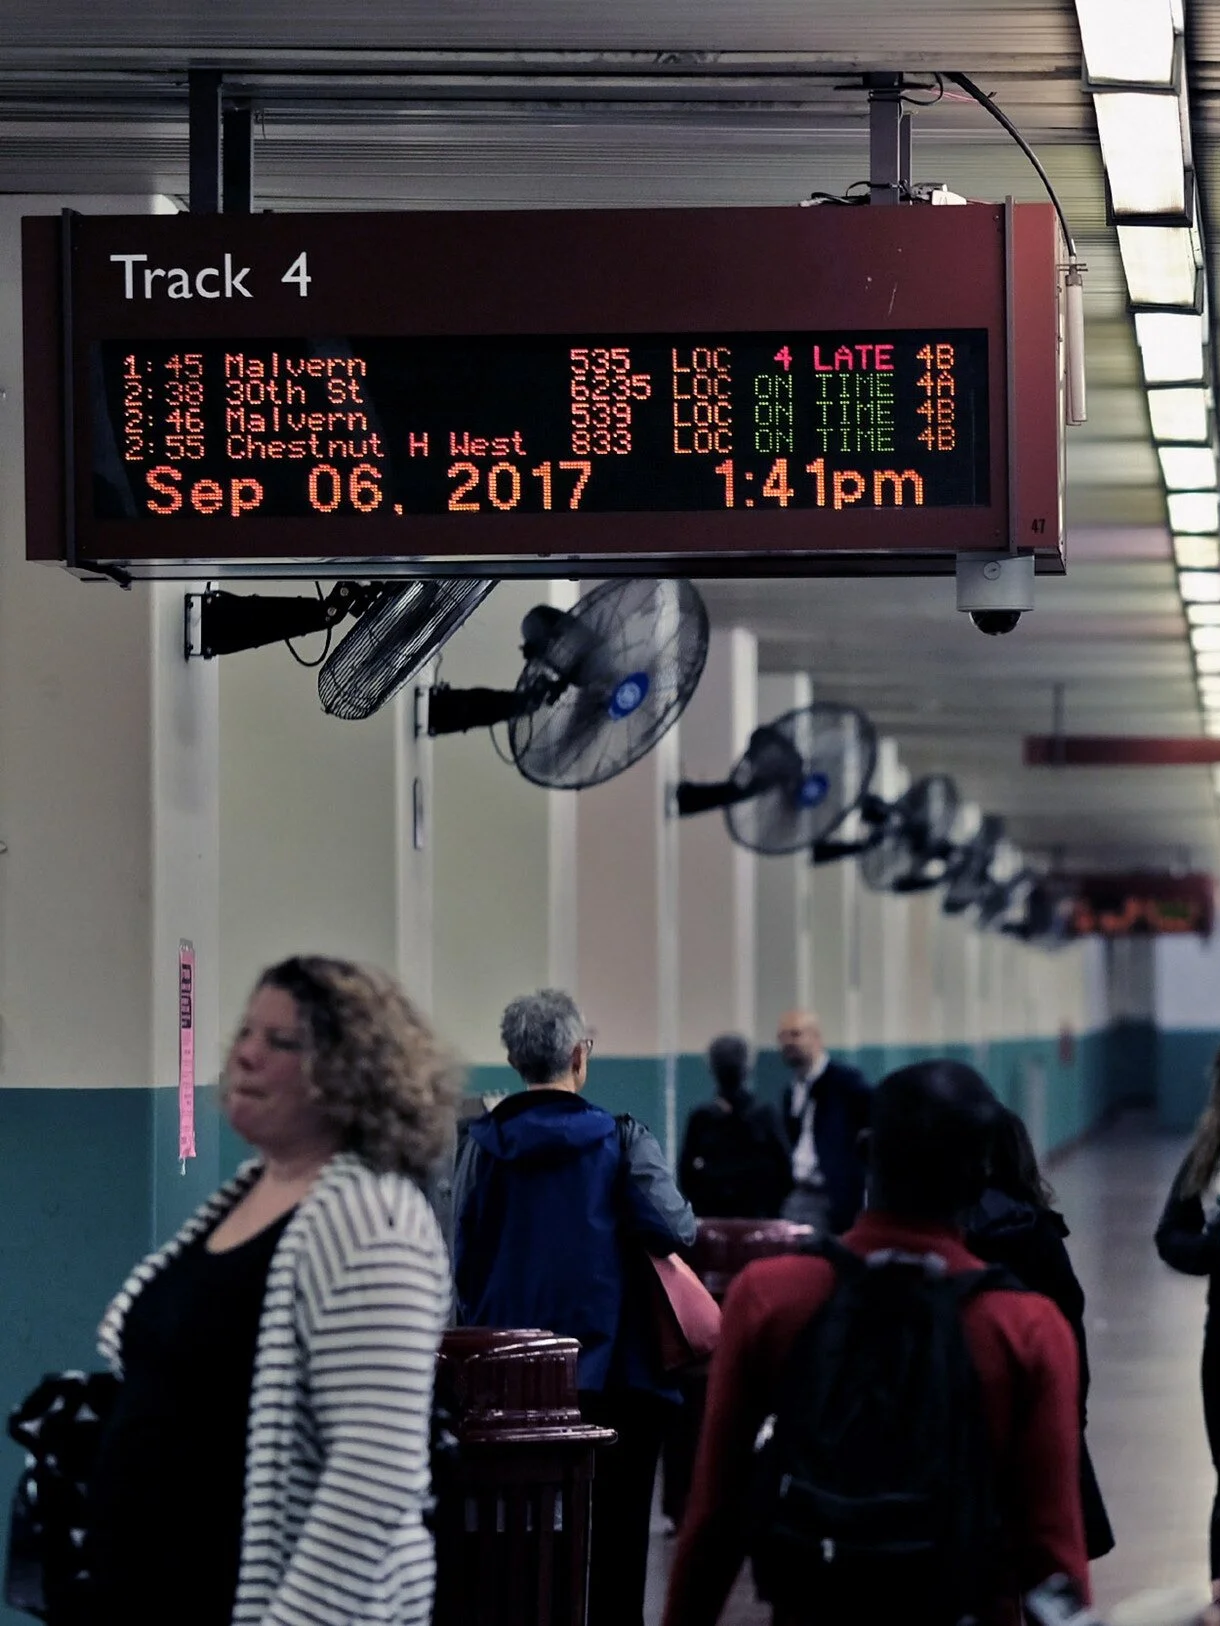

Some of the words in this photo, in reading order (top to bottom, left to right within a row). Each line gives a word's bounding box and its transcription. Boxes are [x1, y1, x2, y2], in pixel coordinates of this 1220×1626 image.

[110, 254, 253, 299] Track
[281, 252, 311, 296] 4
[124, 354, 203, 378] 1:45
[224, 352, 367, 377] Malvern
[570, 348, 631, 374] 535
[672, 347, 732, 373] LOC
[774, 346, 792, 371] 4
[813, 345, 895, 371] LATE
[916, 343, 954, 370] 4B
[225, 379, 306, 405] 30th
[327, 379, 364, 404] St
[571, 374, 652, 401] 6235
[673, 374, 732, 400] LOC
[754, 374, 793, 399] ON
[815, 373, 895, 398] TIME
[916, 370, 955, 397] 4A
[225, 406, 368, 432] Malvern
[571, 402, 632, 428] 539
[674, 402, 733, 427] LOC
[754, 401, 793, 426] ON
[815, 400, 895, 425] TIME
[916, 398, 955, 424] 4B
[125, 435, 205, 460] 2:55
[226, 433, 385, 459] Chestnut
[409, 432, 429, 457] H
[449, 431, 527, 456] West
[572, 429, 632, 455] 833
[674, 428, 734, 454] LOC
[755, 428, 793, 453] ON
[816, 427, 895, 452] TIME
[917, 425, 956, 451] 4B
[146, 465, 264, 517] Sep
[447, 460, 593, 512] 2017
[715, 457, 924, 511] 1:41pm
[1031, 518, 1046, 534] 47
